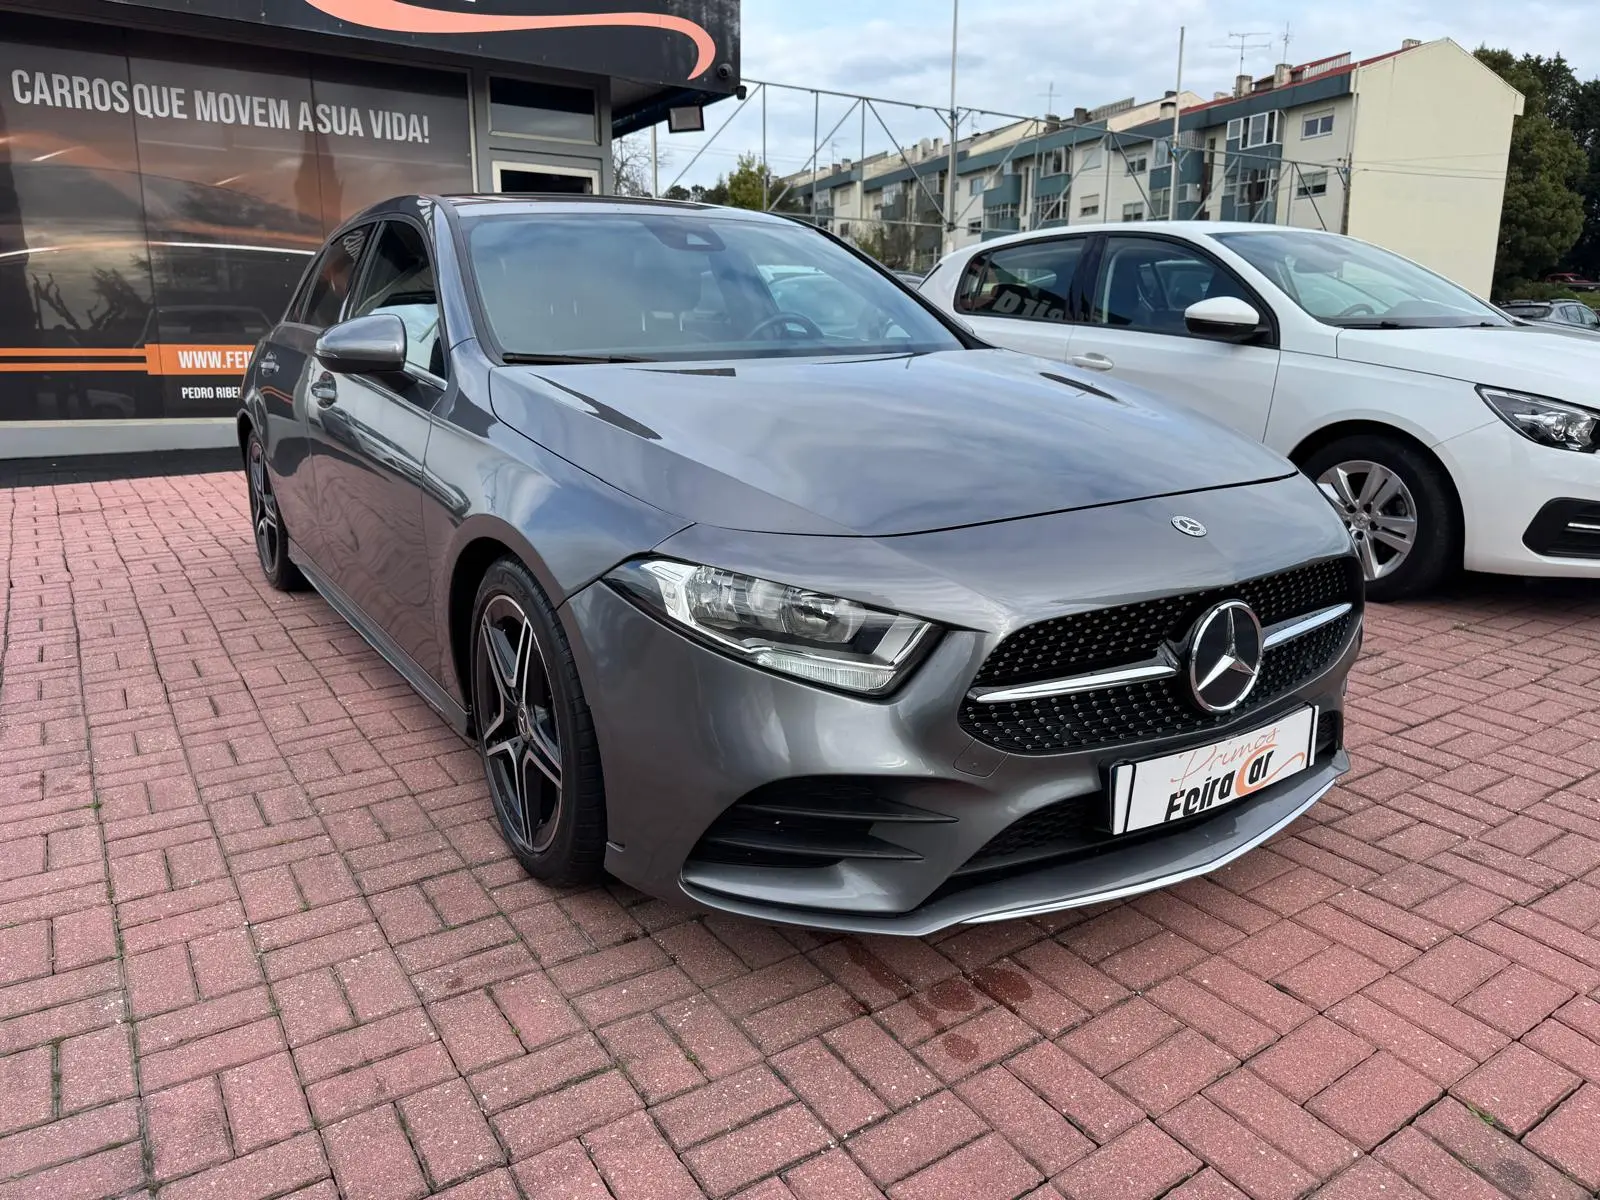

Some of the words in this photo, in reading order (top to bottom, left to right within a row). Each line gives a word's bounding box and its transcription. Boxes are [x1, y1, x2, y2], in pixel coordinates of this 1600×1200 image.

[11, 69, 130, 114] CARROS
[134, 83, 187, 120] QUE
[194, 90, 290, 130] MOVEM
[298, 101, 314, 132] A
[316, 103, 364, 137] SUA
[369, 109, 430, 144] VIDA!
[178, 351, 253, 369] WWW.FEI
[181, 386, 214, 399] PEDRO
[1170, 726, 1281, 797] Primos
